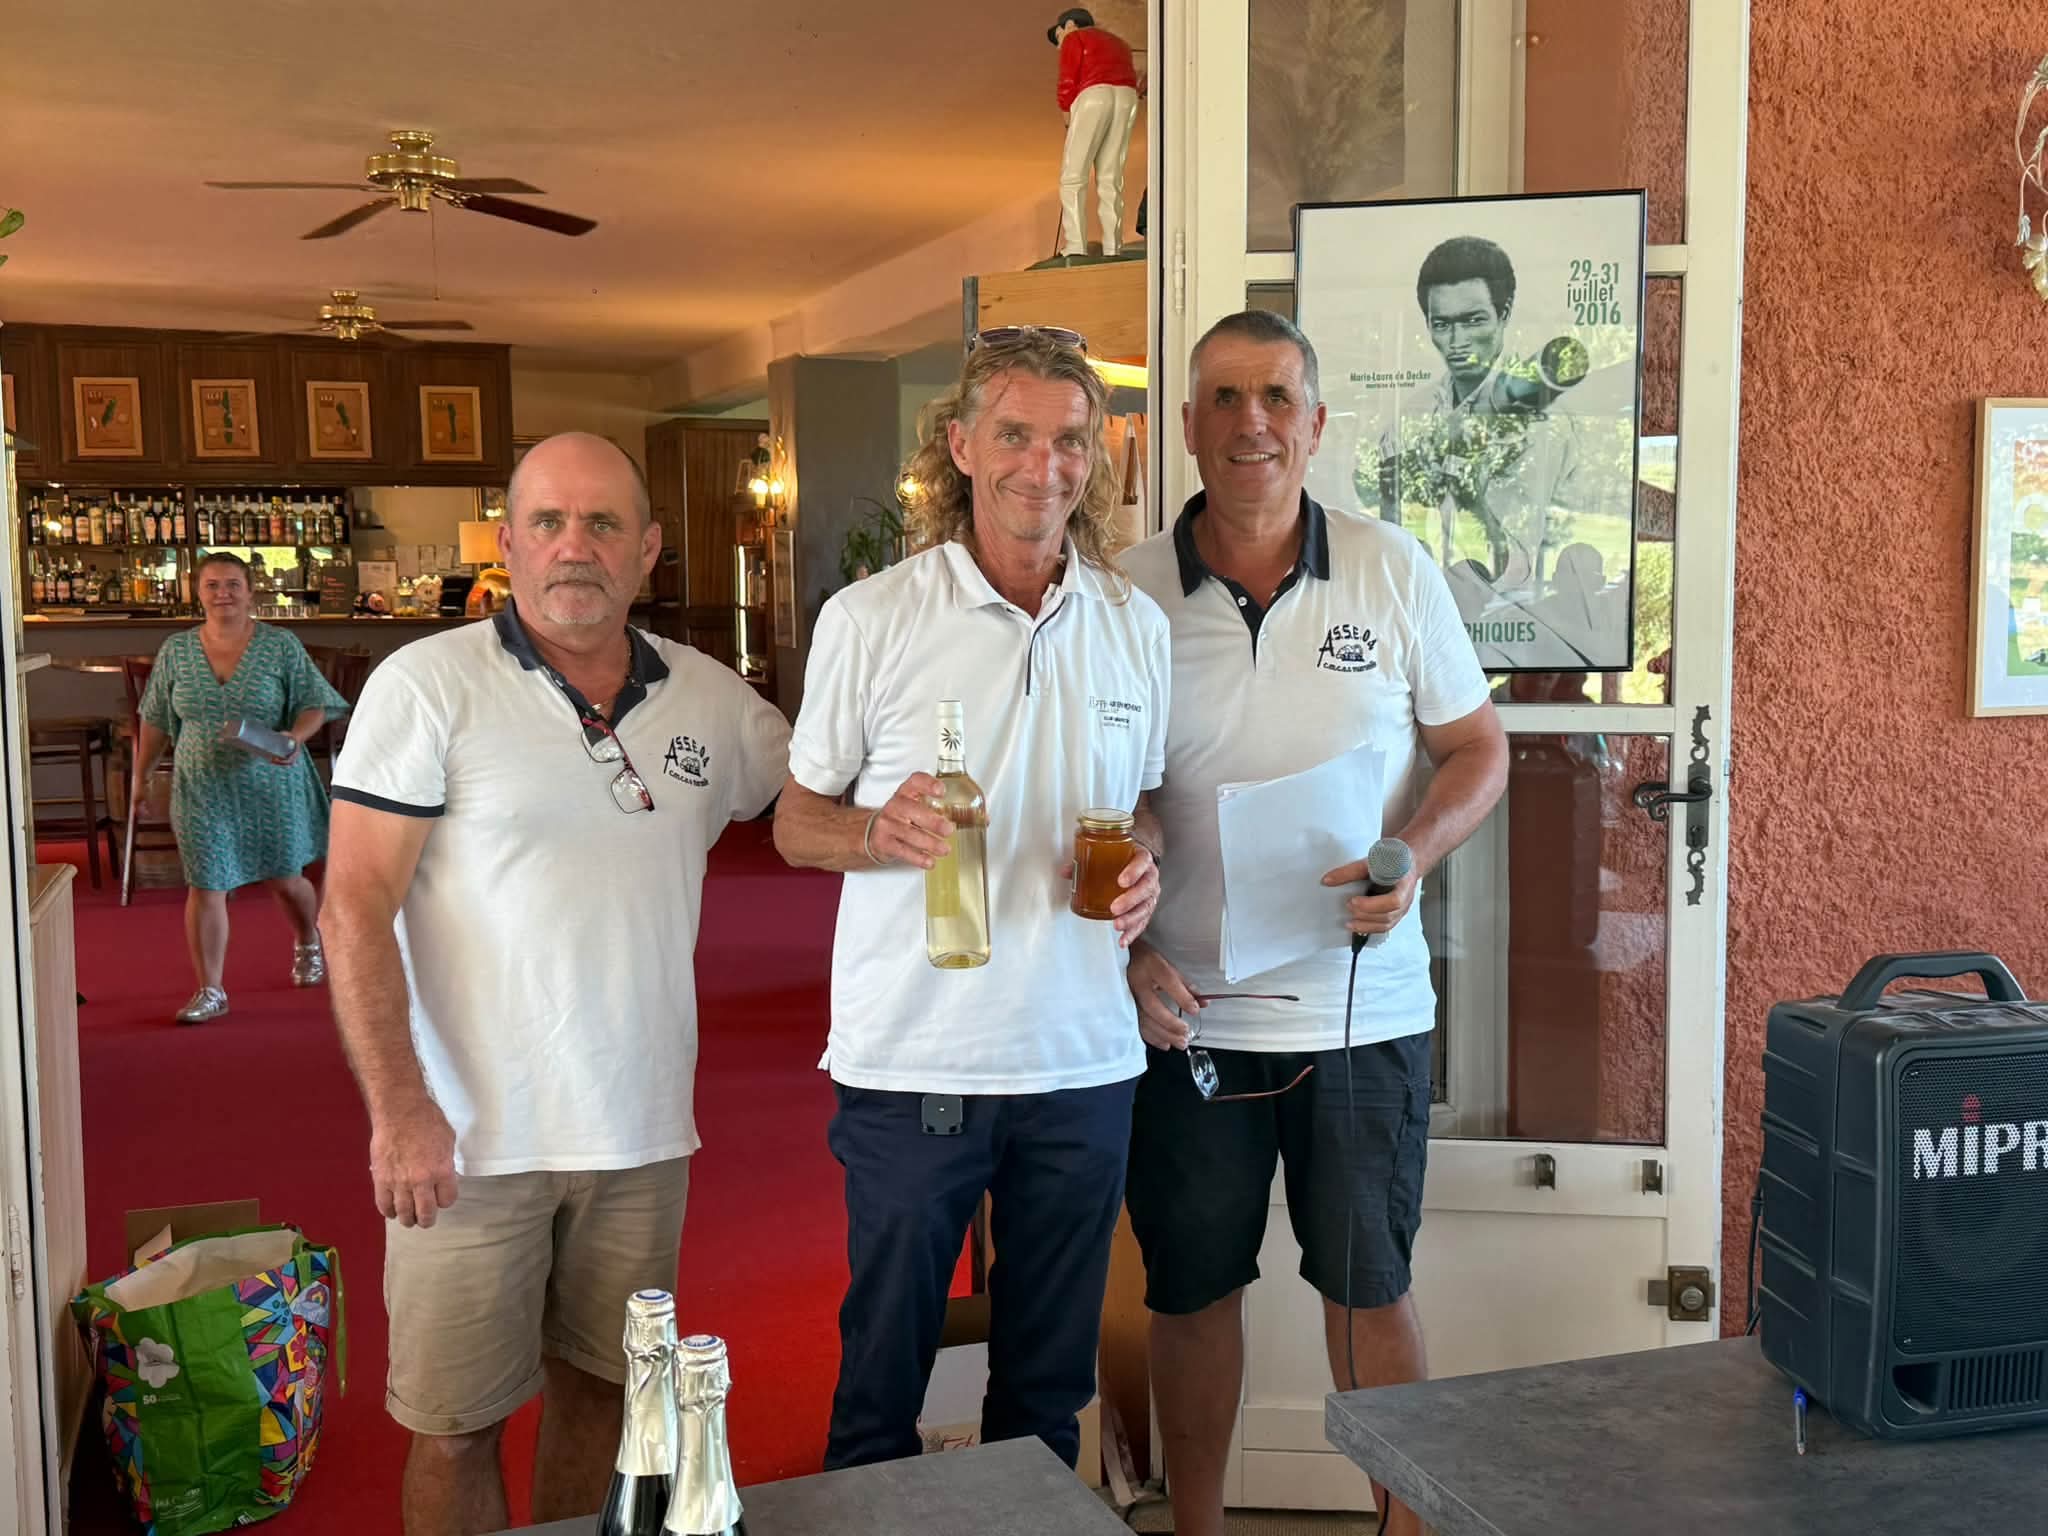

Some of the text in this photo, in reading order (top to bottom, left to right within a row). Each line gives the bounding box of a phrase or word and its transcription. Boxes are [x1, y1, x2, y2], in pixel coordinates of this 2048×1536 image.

[1570, 259, 1619, 285] 29-31
[1567, 279, 1614, 308] juillet
[1574, 301, 1621, 327] 2016
